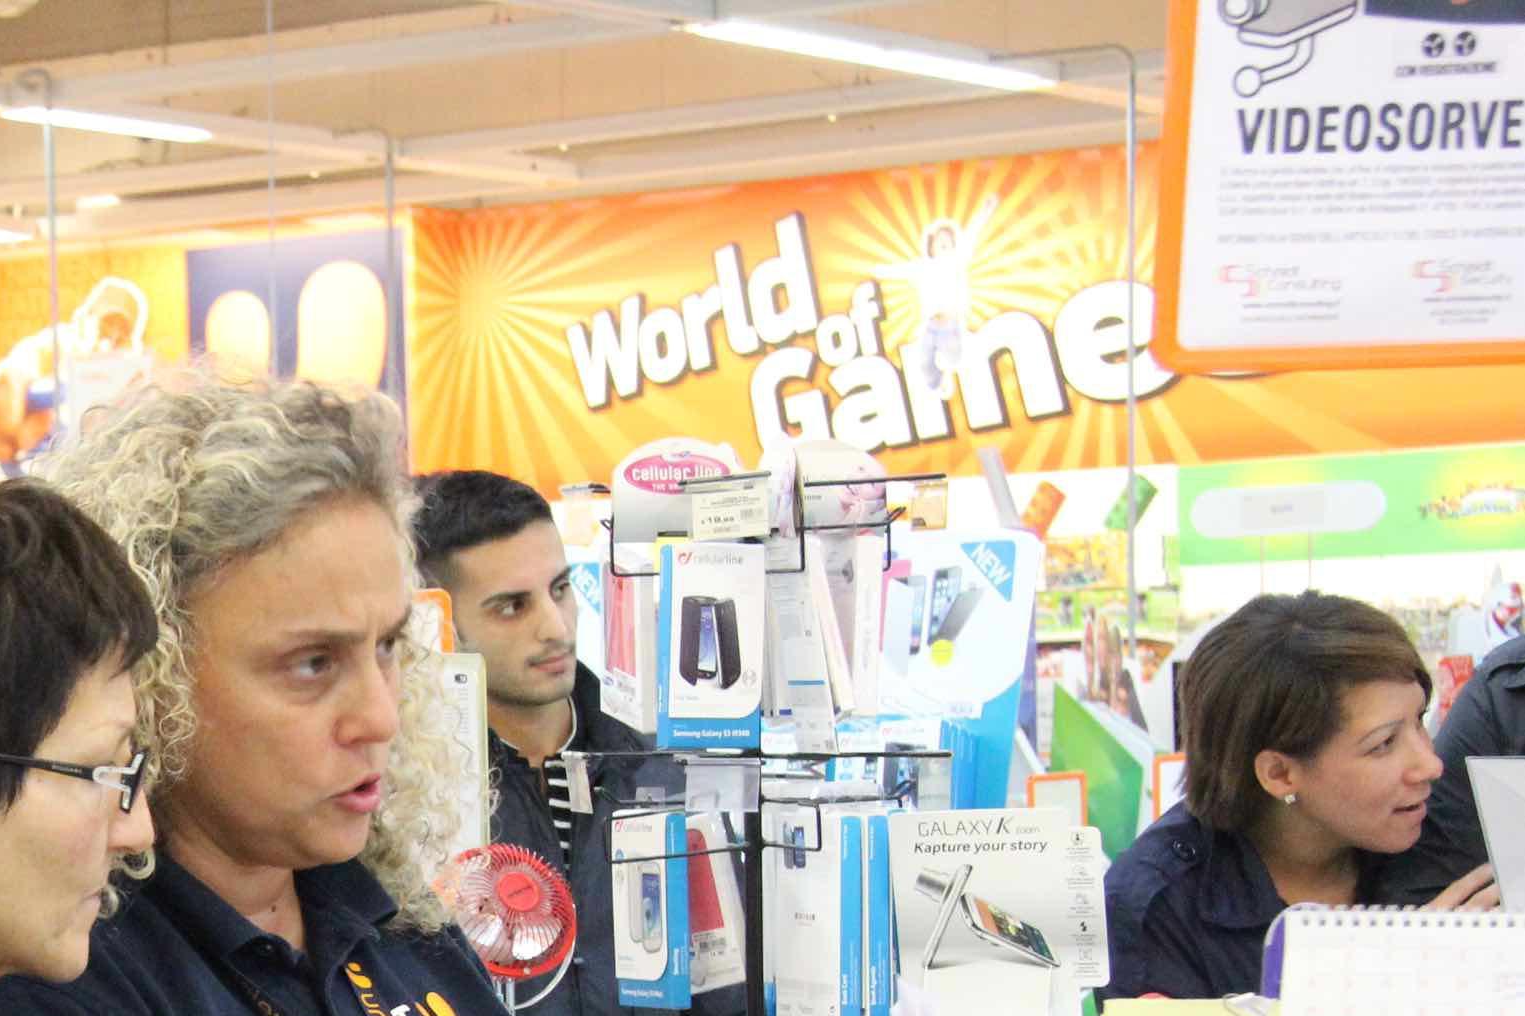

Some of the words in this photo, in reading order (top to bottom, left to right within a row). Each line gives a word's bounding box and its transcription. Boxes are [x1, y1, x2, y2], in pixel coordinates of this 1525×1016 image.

[1237, 99, 1525, 155] VIDEOSORVE
[566, 211, 819, 410] World
[815, 281, 883, 368] of
[750, 279, 1176, 456] Game
[631, 464, 691, 482] cellular
[970, 541, 1013, 587] NEW
[914, 841, 971, 856] Kapture
[974, 842, 1006, 856] your
[1010, 840, 1049, 853] story
[917, 818, 993, 838] GALAXY
[995, 816, 1014, 835] K
